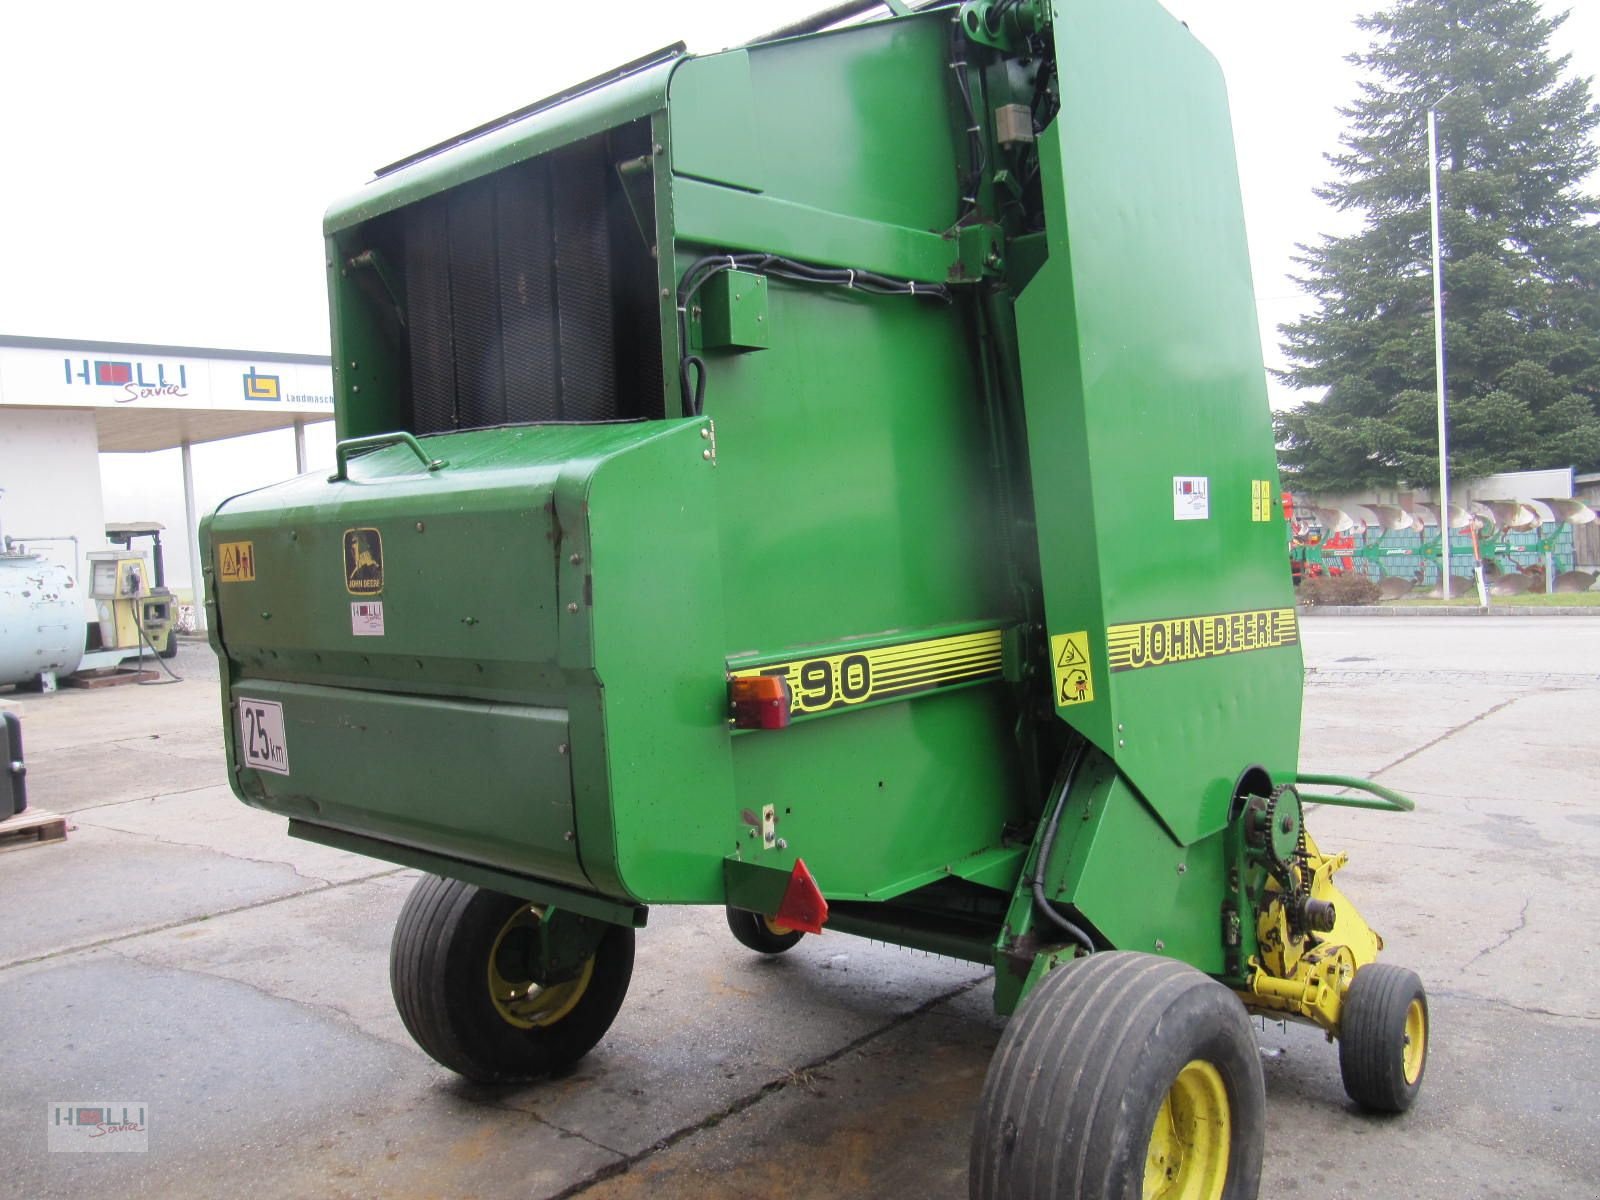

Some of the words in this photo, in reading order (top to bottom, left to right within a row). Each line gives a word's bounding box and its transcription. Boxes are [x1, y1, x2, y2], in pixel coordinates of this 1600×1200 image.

[65, 359, 187, 388] HOLLI
[115, 379, 189, 403] Service
[349, 579, 363, 588] JOHN
[364, 579, 380, 588] DEERE
[1131, 618, 1205, 664] JOHN
[1213, 611, 1280, 651] DEERE
[760, 654, 870, 708] 90
